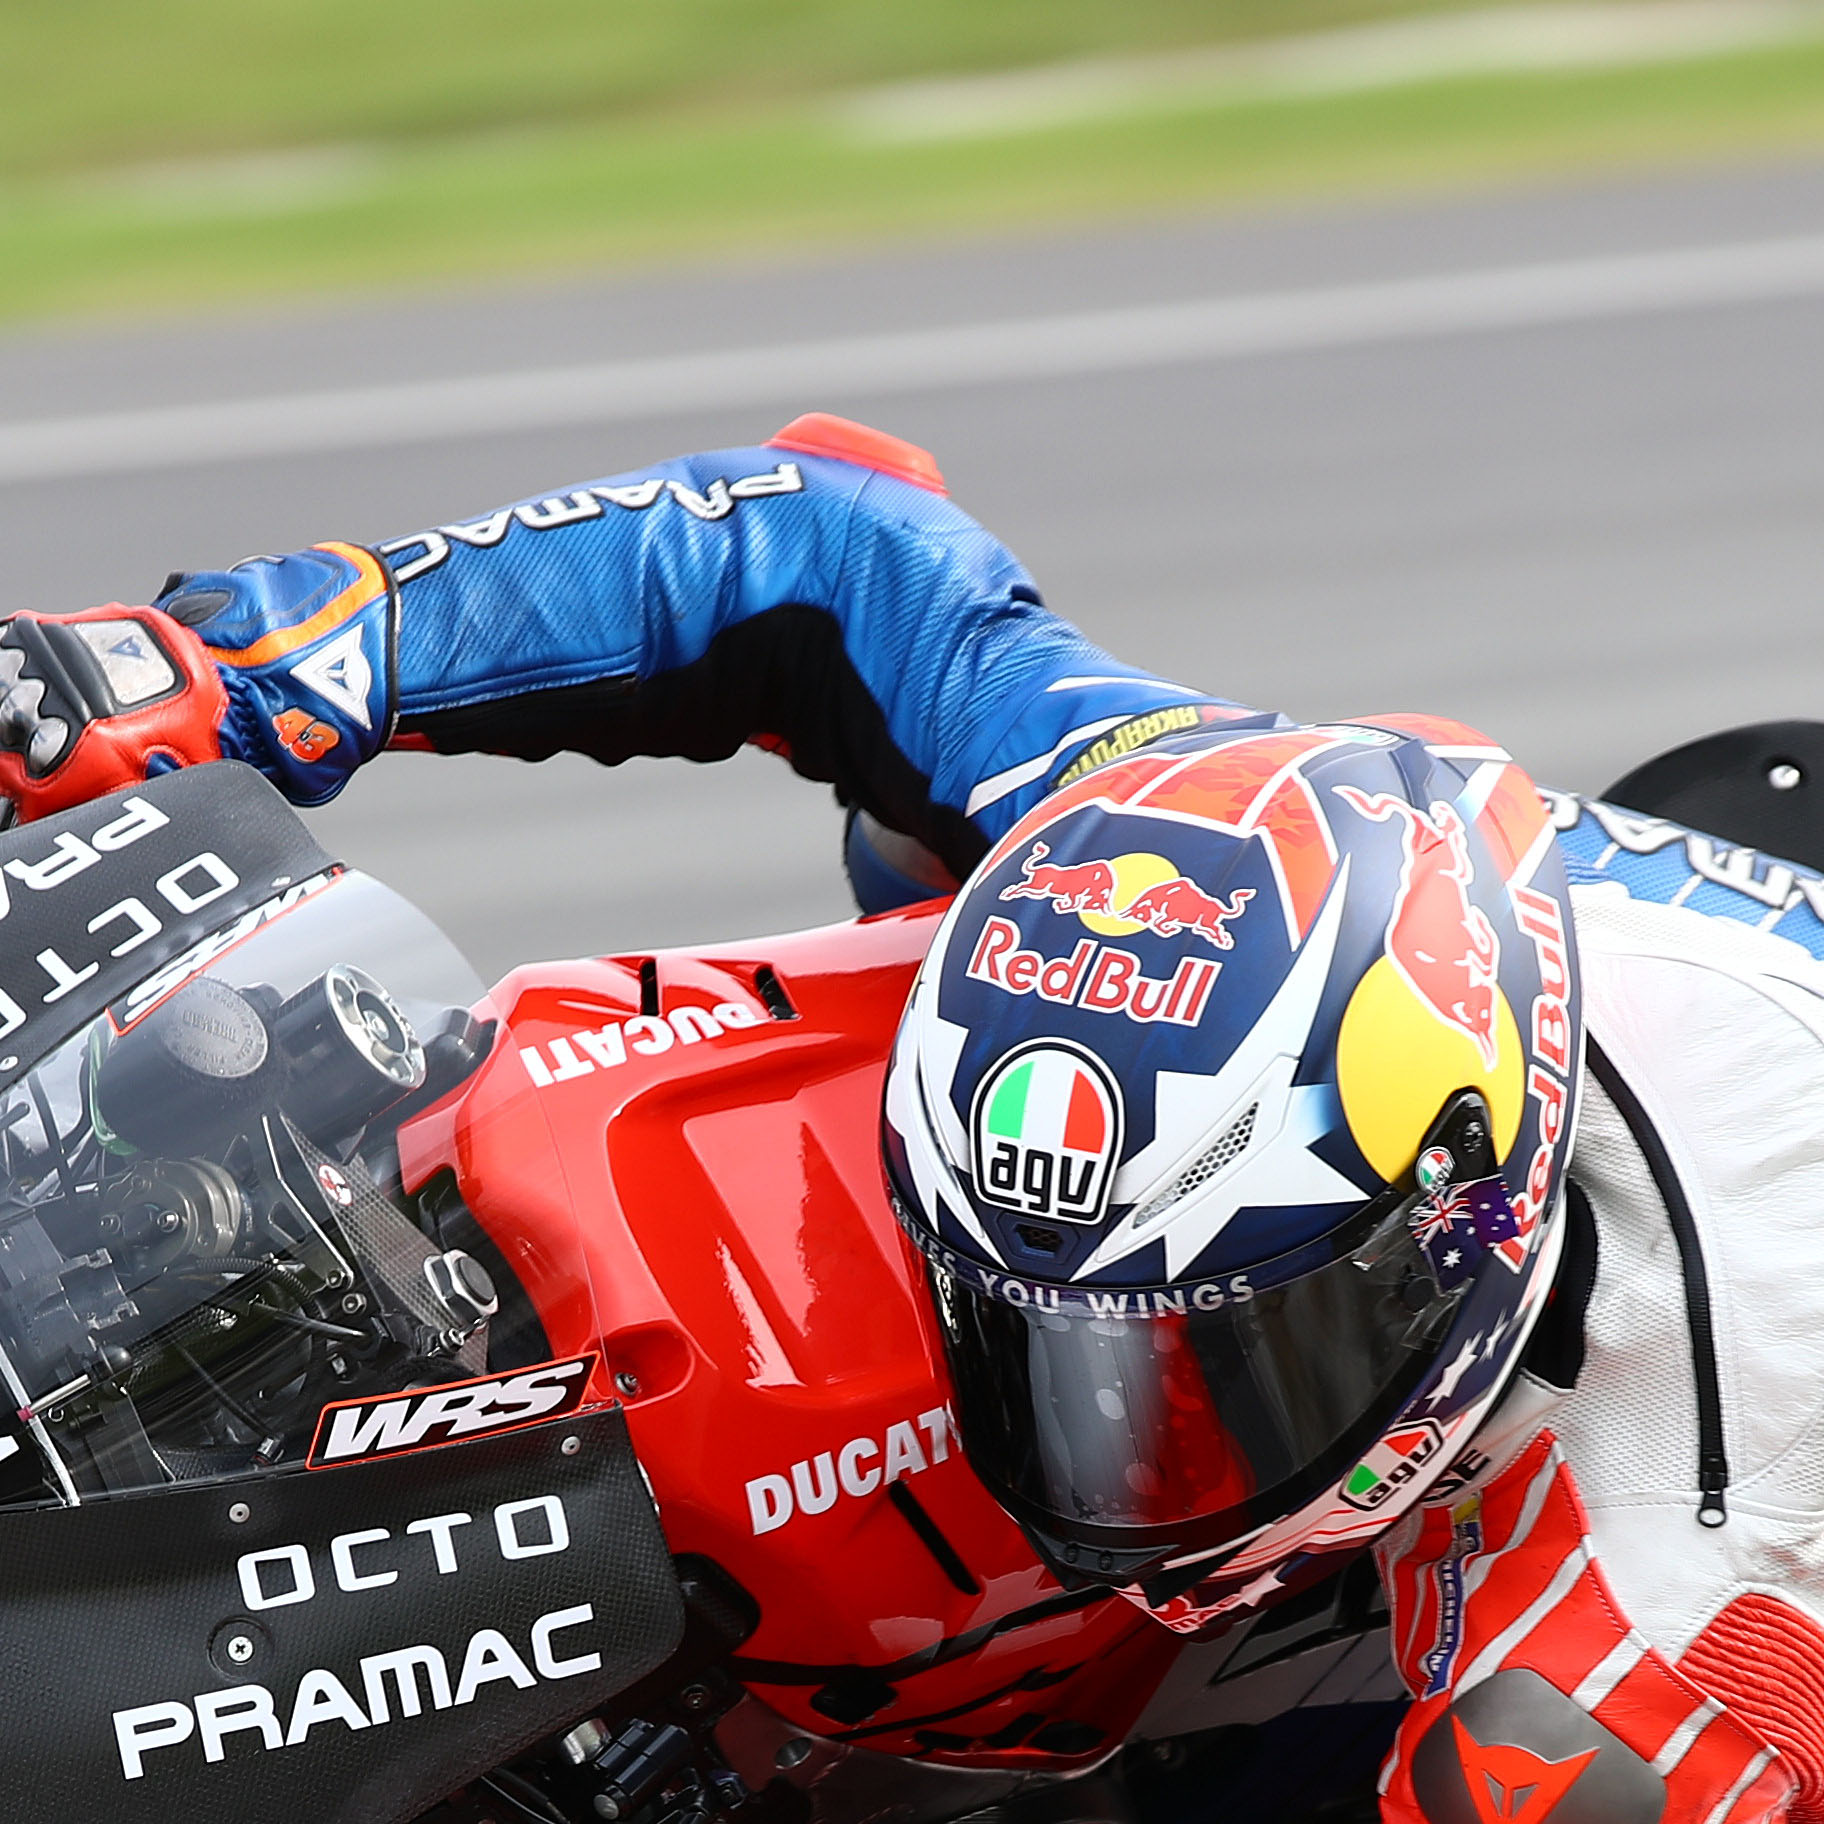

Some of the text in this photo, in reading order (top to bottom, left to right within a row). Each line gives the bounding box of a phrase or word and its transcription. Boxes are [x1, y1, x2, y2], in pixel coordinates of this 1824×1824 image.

[378, 461, 805, 585] PRAMAC
[272, 706, 342, 764] 43
[521, 1002, 771, 1088] DUCATI
[990, 1141, 1096, 1214] agv
[978, 1270, 1060, 1314] YOU
[1087, 1274, 1255, 1319] WINGS
[324, 1361, 585, 1460] WRS
[1363, 1436, 1438, 1505] agv
[237, 1495, 571, 1611] OCTO
[112, 1603, 602, 1780] PRAMAC
